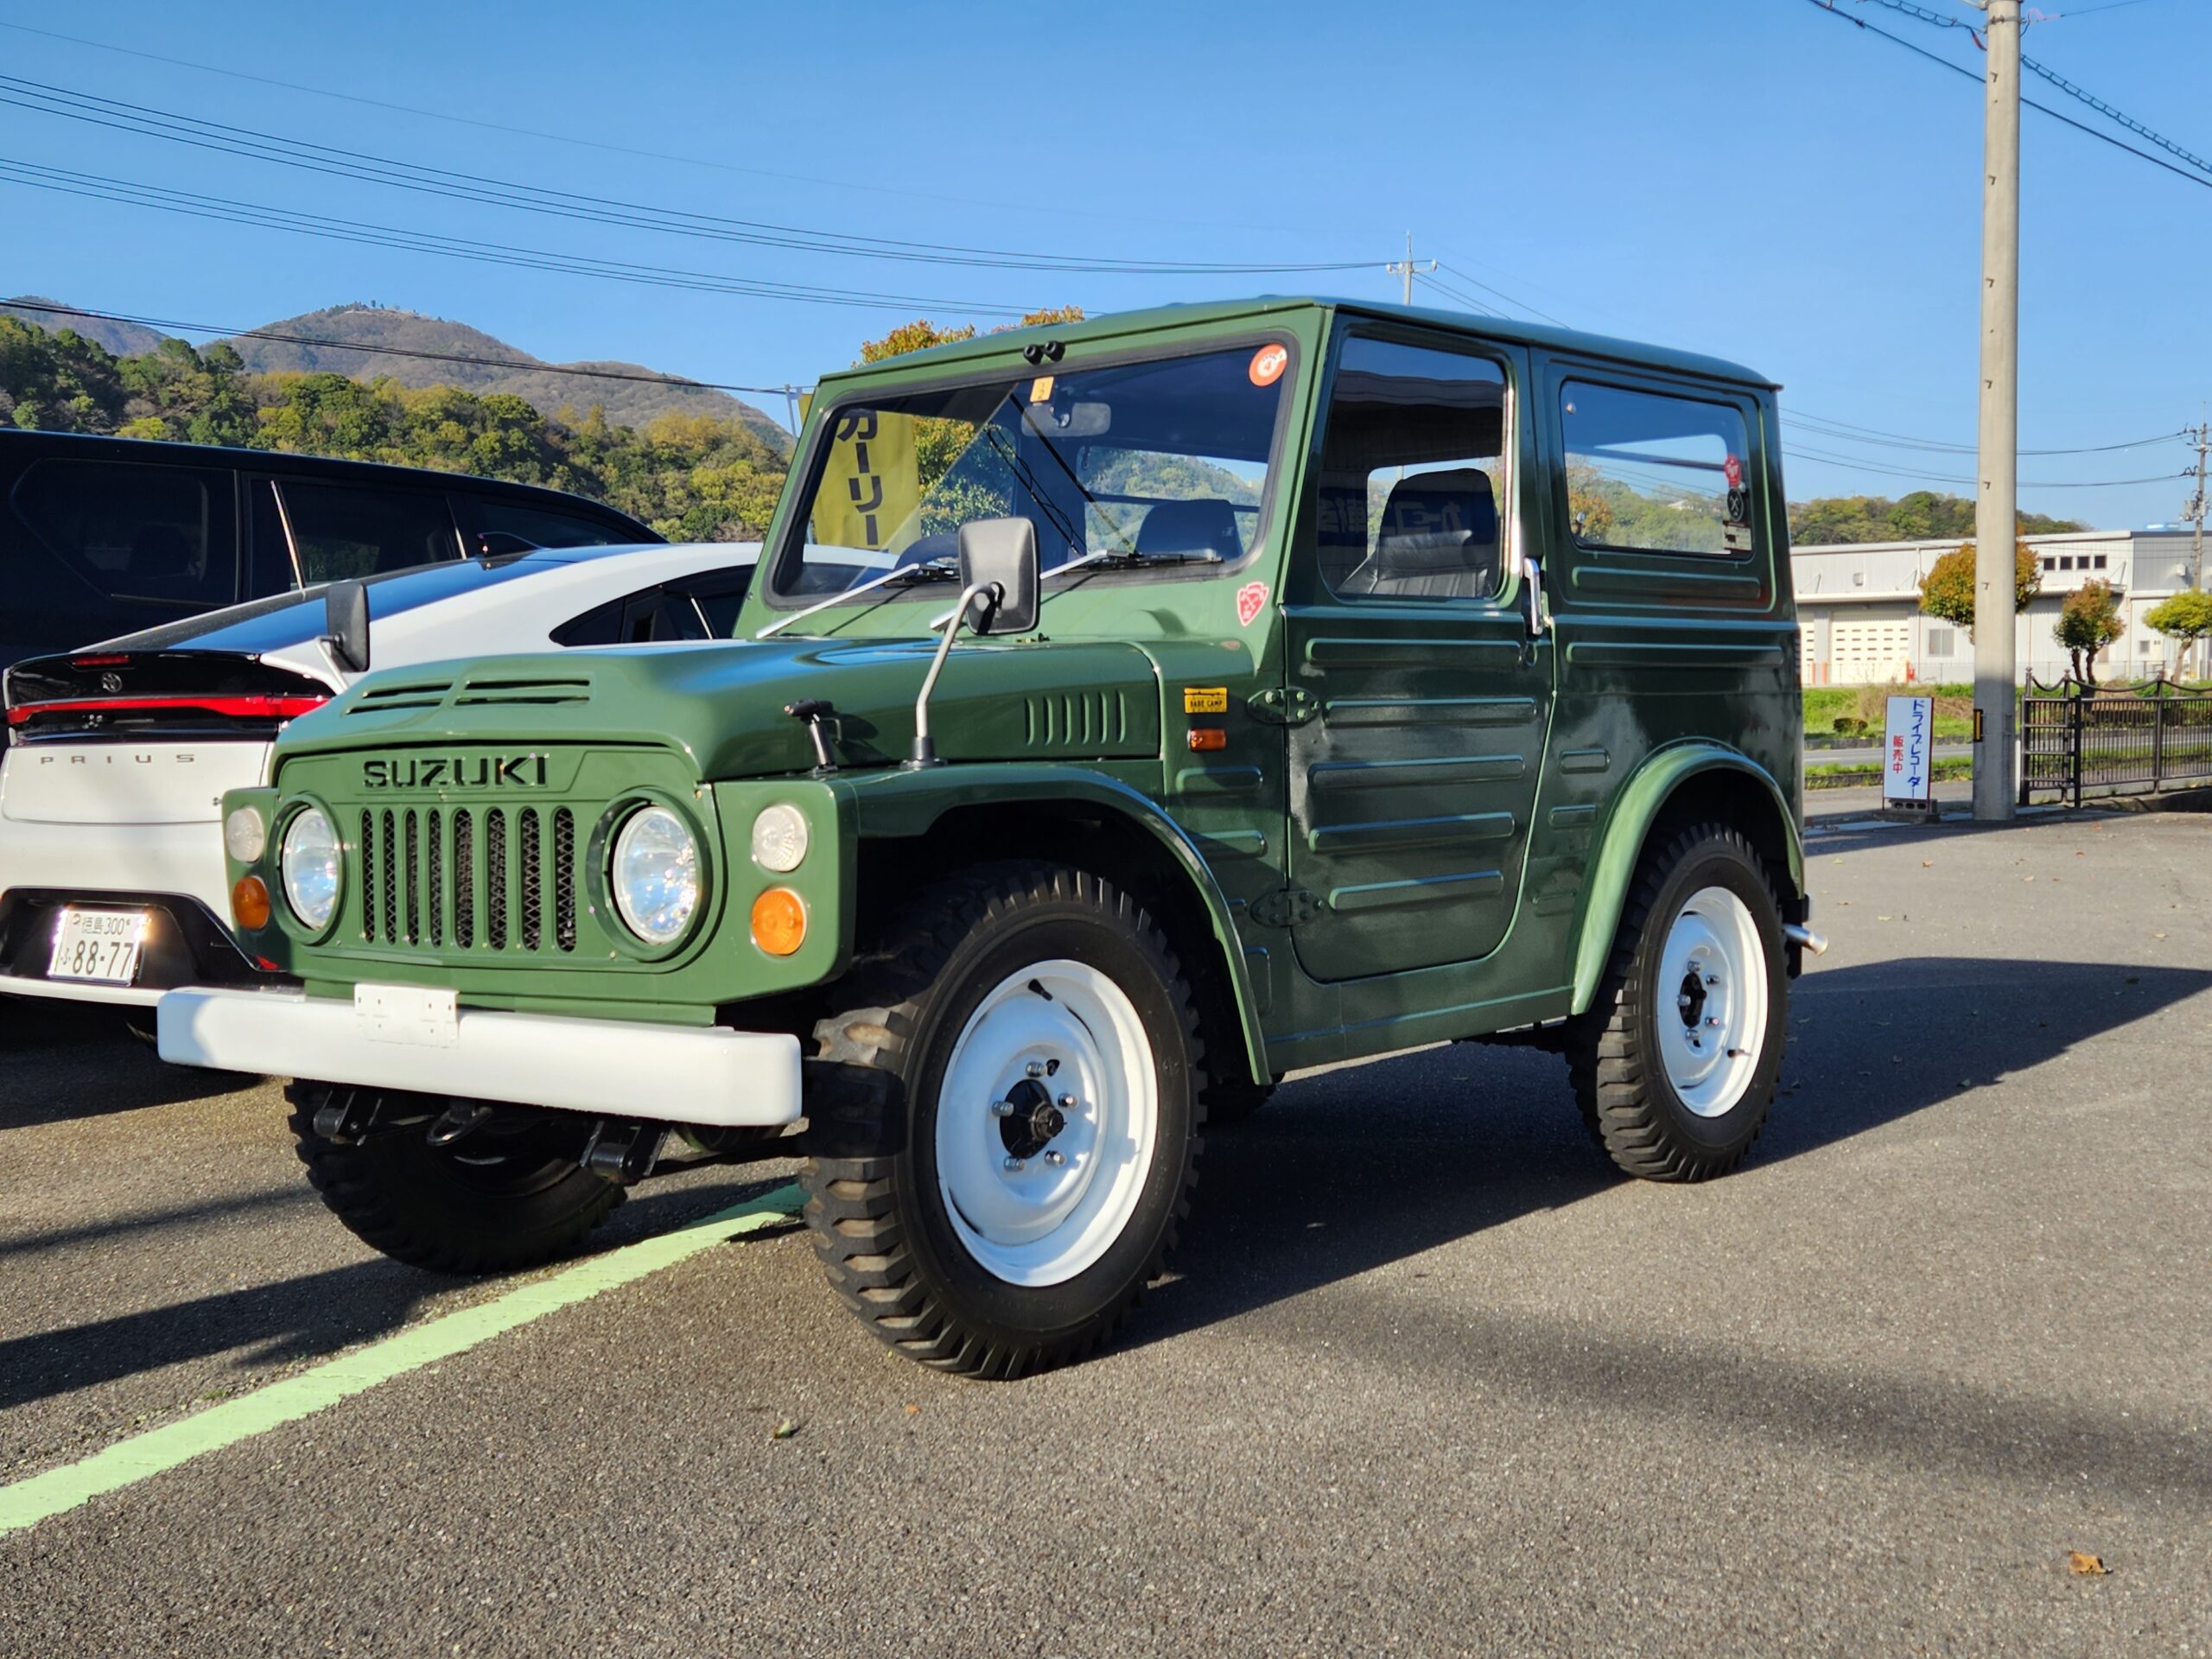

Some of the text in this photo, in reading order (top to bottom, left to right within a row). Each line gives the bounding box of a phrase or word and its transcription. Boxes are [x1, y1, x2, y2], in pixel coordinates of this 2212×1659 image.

[836, 409, 888, 554] カーリー
[40, 753, 195, 766] PRIUS
[1893, 734, 1904, 774] 販売中
[1907, 699, 1925, 799] ドライブレコーダー
[363, 754, 549, 790] SUZUKI
[104, 917, 124, 935] 300
[73, 939, 134, 978] 88-77
